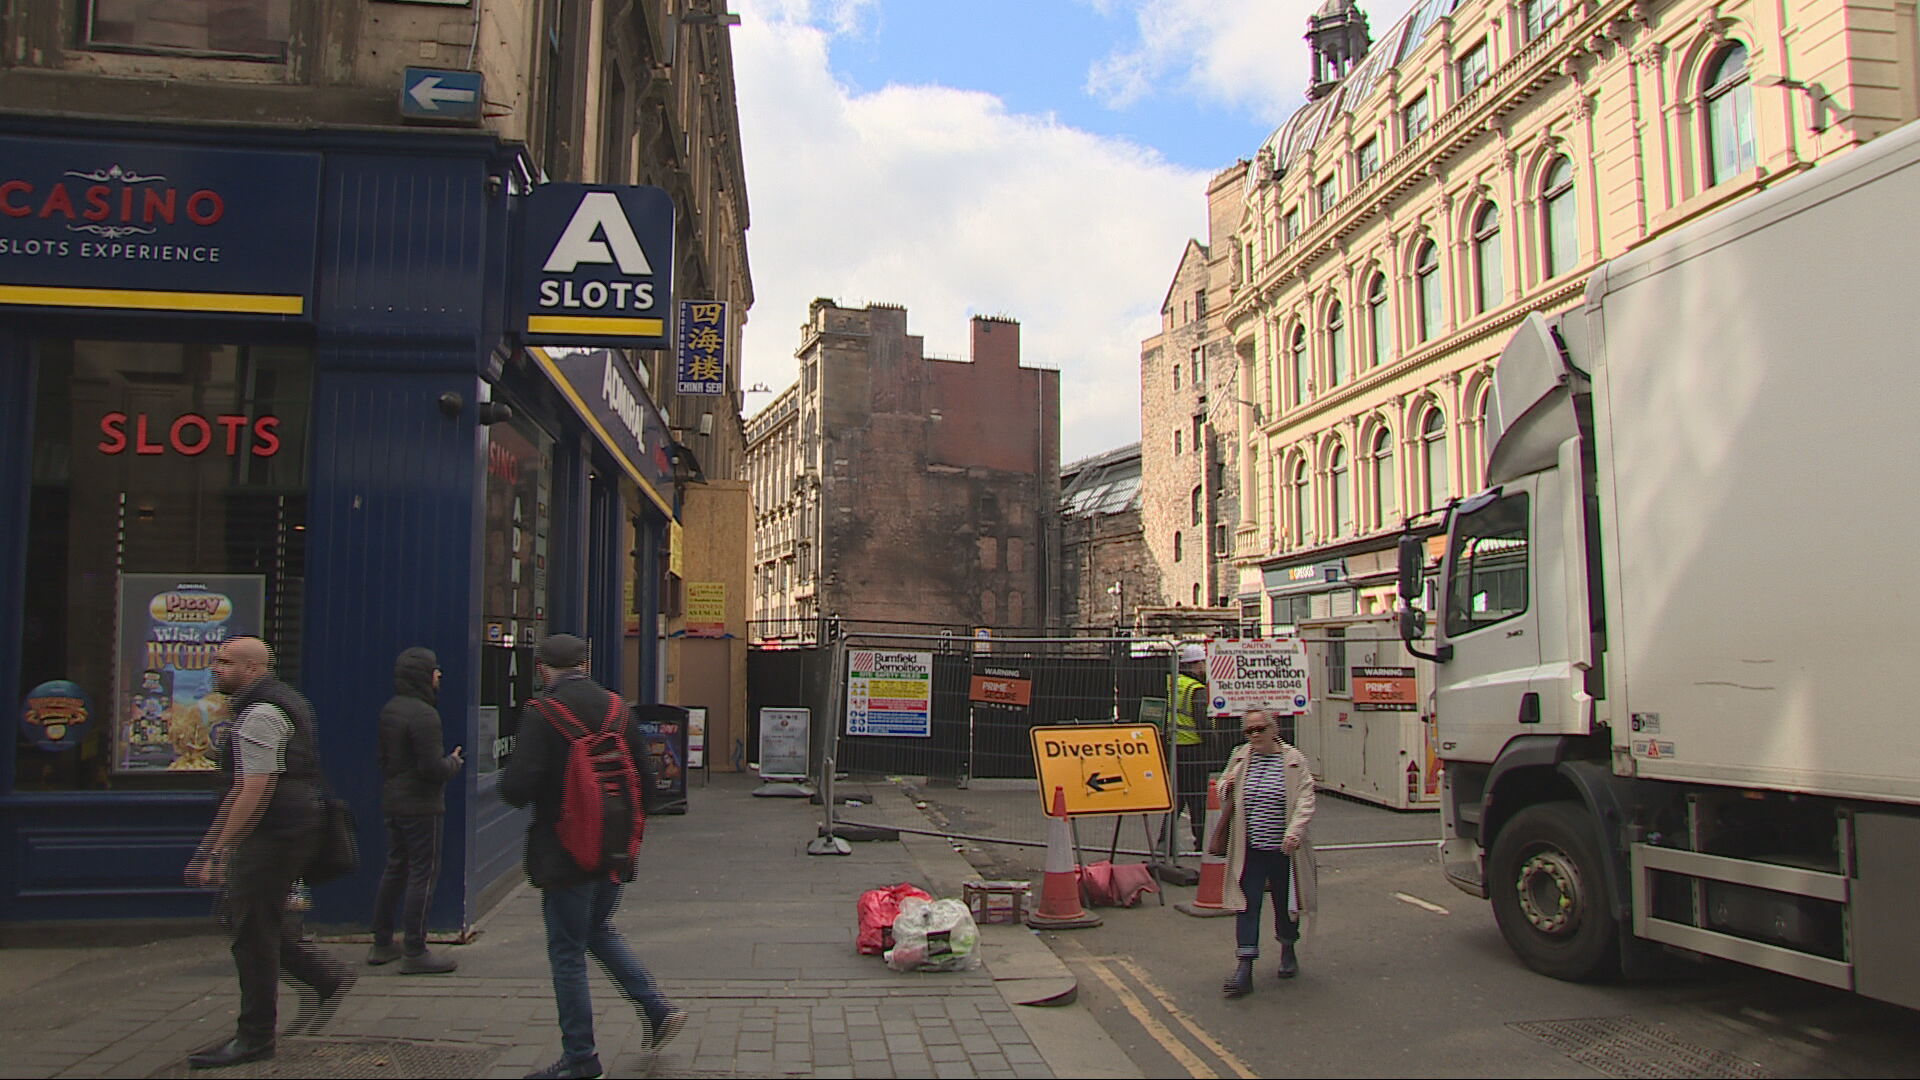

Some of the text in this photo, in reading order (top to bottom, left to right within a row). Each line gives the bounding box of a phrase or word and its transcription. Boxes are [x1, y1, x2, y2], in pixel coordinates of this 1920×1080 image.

[0, 180, 225, 226] CASINO
[542, 191, 654, 276] A
[0, 238, 221, 263] SLOTS EXPERIENCE
[539, 280, 655, 311] SLOTS
[679, 381, 722, 394] CHINA SEA
[602, 350, 646, 455] ADMIRAL
[99, 412, 281, 457] SLOTS
[147, 641, 221, 671] RICHE
[1236, 655, 1292, 667] Burnfield
[874, 662, 927, 673] Demolition
[984, 667, 1020, 677] WARNING
[1236, 667, 1305, 679] Demolition
[1364, 668, 1403, 676] WARNING
[1216, 680, 1302, 690] Tel: 0141 554 8046
[1365, 682, 1393, 692] PRIME
[1044, 738, 1150, 757] Diversion
